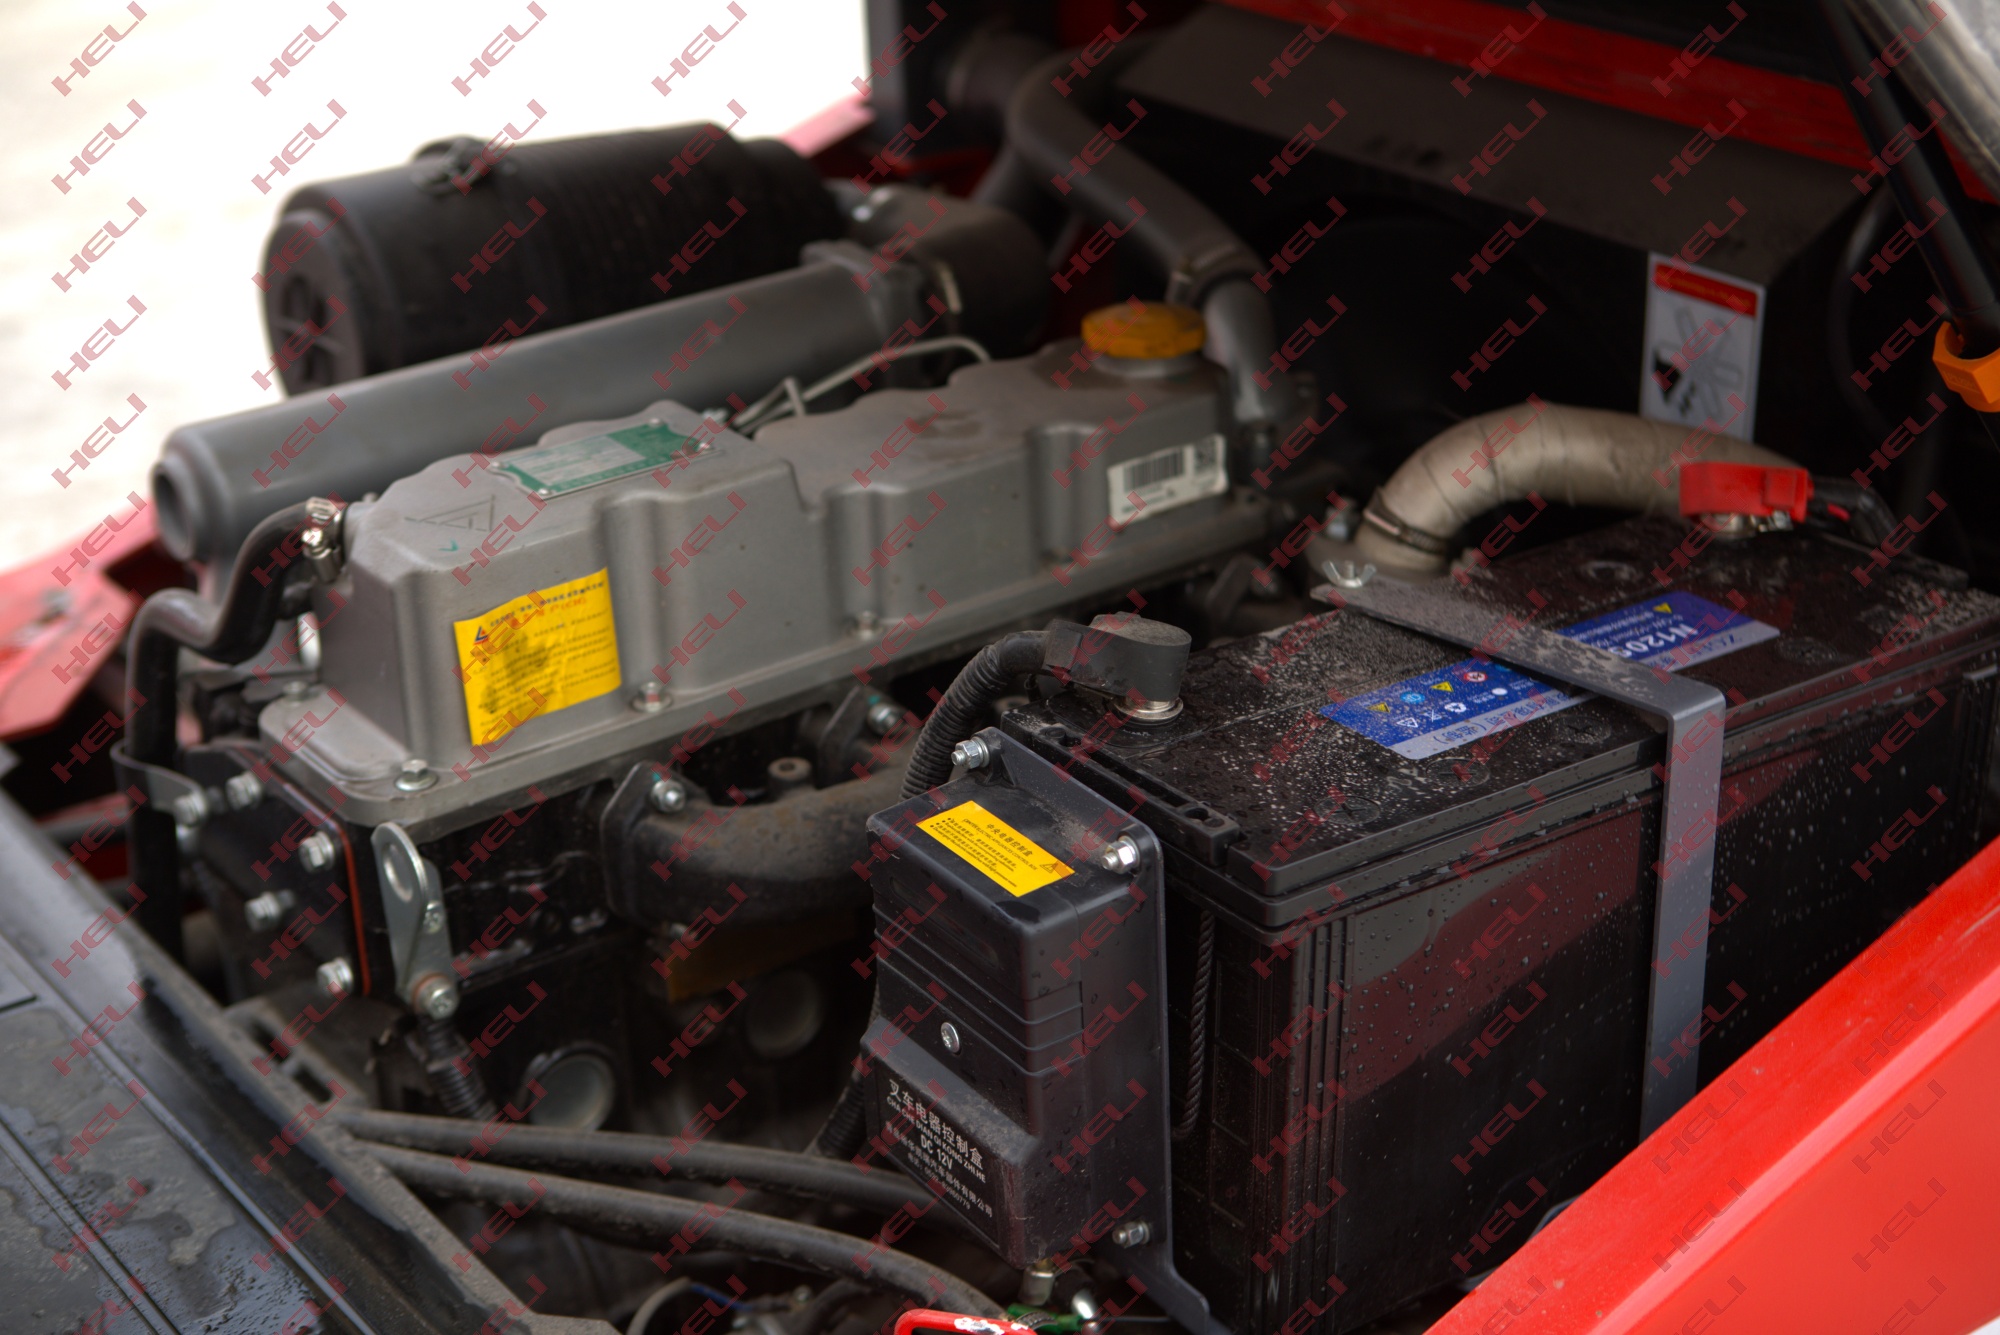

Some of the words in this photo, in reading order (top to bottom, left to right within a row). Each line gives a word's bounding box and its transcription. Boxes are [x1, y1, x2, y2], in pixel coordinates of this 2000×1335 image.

[986, 823, 1033, 857] 中央电器控制盒
[889, 1079, 983, 1170] 叉车电器控制盒
[916, 1120, 934, 1139] DIAN
[942, 1141, 963, 1164] KONG
[920, 1134, 934, 1154] DC
[937, 1149, 953, 1170] 12V
